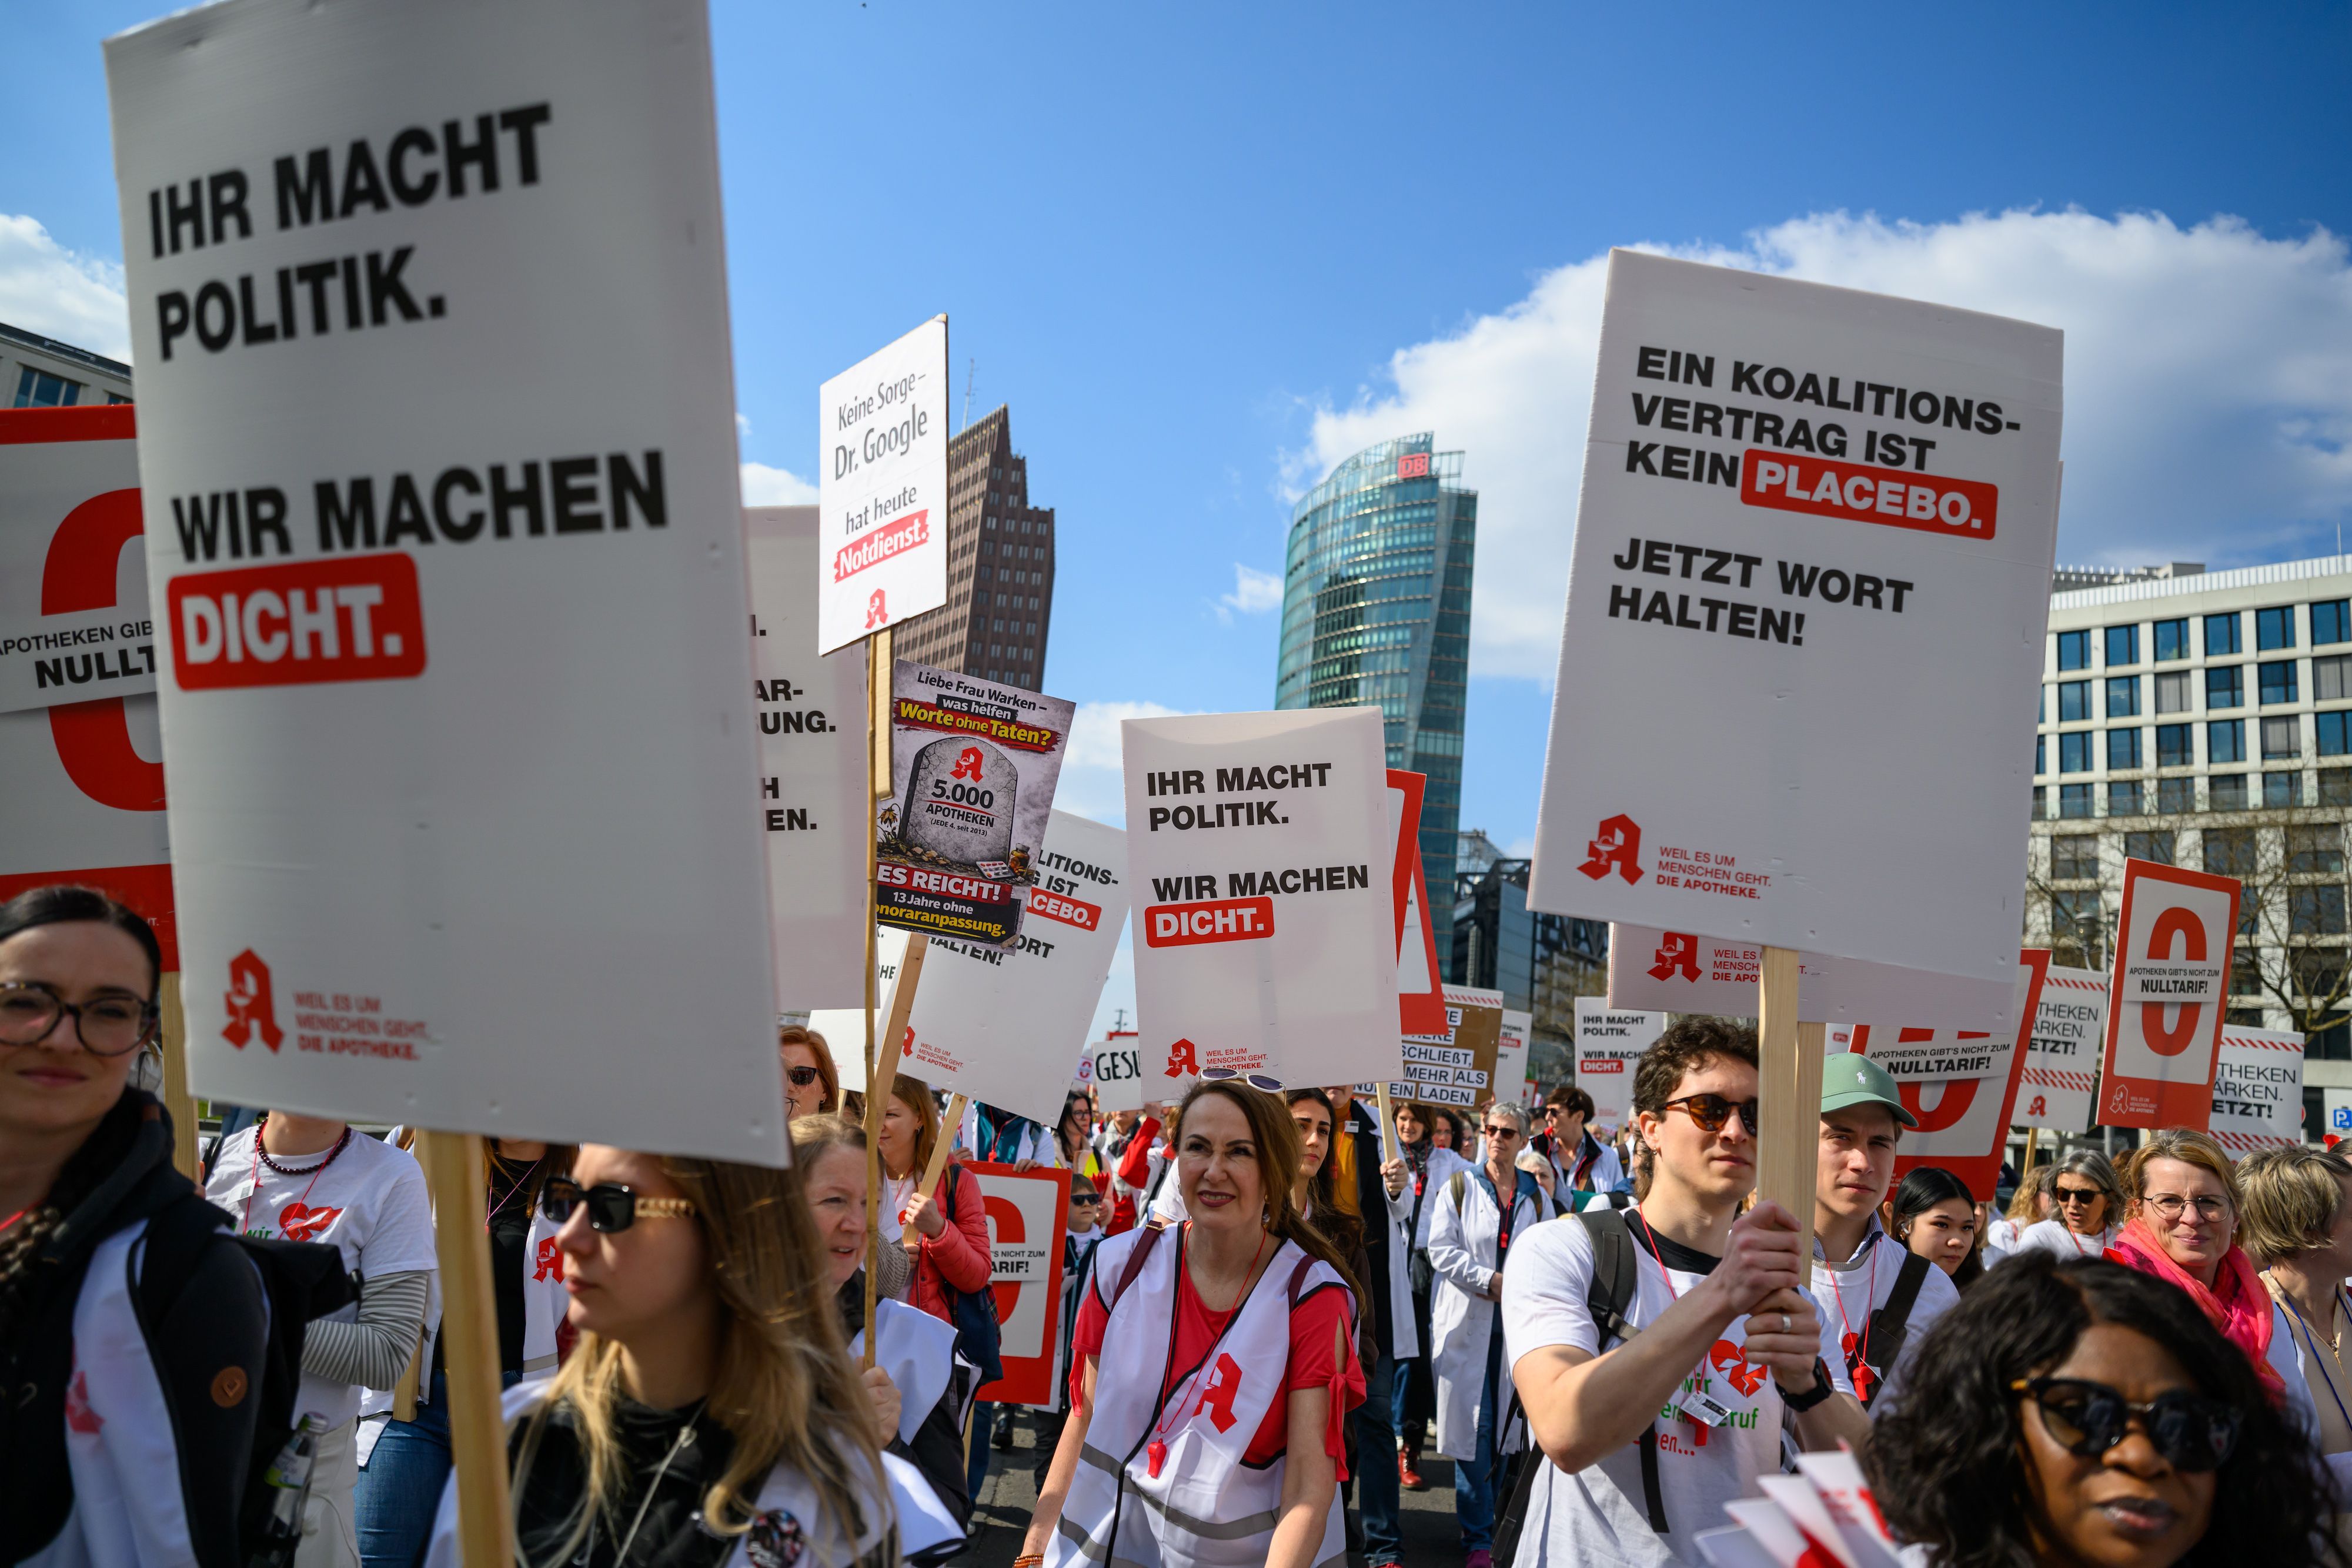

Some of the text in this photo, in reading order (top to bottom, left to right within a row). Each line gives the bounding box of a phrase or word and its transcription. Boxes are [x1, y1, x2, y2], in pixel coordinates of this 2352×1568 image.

[148, 101, 553, 260] IHR MACHT
[155, 244, 447, 363] POLITIK.
[838, 396, 874, 431] Keine
[877, 373, 916, 410] Sorge
[1636, 346, 2022, 436] EIN KOALITIONS-
[835, 403, 928, 481] Dr. Google
[1631, 392, 1936, 472] VERTRAG IST
[1401, 458, 1424, 474] DB
[1626, 440, 1983, 529] KEIN PLACEBO.
[171, 447, 669, 563] WIR MACHEN
[846, 486, 917, 536] hat heute
[839, 517, 927, 577] Notdienst.
[1613, 538, 1914, 614] JETZT WORT
[179, 583, 405, 665] DICHT.
[1608, 584, 1806, 647] HALTEN!
[119, 620, 154, 639] GIB
[35, 646, 156, 689] NULLT
[917, 671, 953, 690] Liebe
[956, 680, 985, 698] Frau
[988, 688, 1037, 711] Warken
[943, 698, 1011, 720] was helfen
[760, 710, 837, 734] UNG.
[900, 701, 1051, 746] Worte ohne Taten?
[1147, 763, 1332, 797] IHR MACHT
[931, 778, 994, 810] 5.000
[766, 808, 817, 831] EN.
[925, 803, 995, 828] APOTHEKEN
[930, 817, 948, 828] (JEDE
[957, 824, 969, 833] seit
[970, 826, 988, 837] 2013)
[1149, 800, 1289, 832] POLITIK.
[1037, 849, 1119, 885] LITIONS-
[1659, 846, 1736, 867] WEIL ES UM
[877, 864, 1001, 901] ES REICHT!
[1045, 874, 1080, 897] IST
[1151, 864, 1369, 902] WIR MACHEN
[1657, 860, 1772, 887] MENSCHEN GEHT.
[1656, 874, 1762, 900] DIE APOTHEKE.
[893, 891, 974, 915] 13 Jahre ohne
[1027, 891, 1092, 927] CEBO.
[876, 903, 1006, 937] noraranpassung.
[1155, 907, 1264, 938] DICHT.
[1017, 934, 1055, 959] ORT
[1713, 948, 1740, 959] WEIL
[1742, 950, 1756, 960] ES
[1712, 971, 1760, 983] DIE APO
[1713, 960, 1759, 972] MENSCH
[2129, 967, 2167, 976] APOTHEKEN
[2141, 979, 2209, 994] NULLTARIF!
[295, 1013, 380, 1035] MENSCHEN
[1583, 1015, 1646, 1025] IHR MACHT
[2039, 1002, 2099, 1022] THEKEN
[298, 1034, 324, 1052] DIE
[1583, 1028, 1631, 1037] POLITIK.
[918, 1048, 964, 1068] MENSCHEN GEHT.
[920, 1042, 933, 1051] WEIL
[1583, 1051, 1646, 1059] WIR MACH
[1870, 1043, 2011, 1059] APOTHEKEN GIBT'S NICHT ZUM
[2029, 1038, 2077, 1056] ETZT!
[927, 1058, 958, 1073] APOTHEKE.
[1095, 1050, 1141, 1082] GESU
[1207, 1056, 1247, 1065] MENSCHEN
[1582, 1062, 1622, 1072] DICHT.
[1887, 1057, 1992, 1075] NULLTARIF!
[1405, 1066, 1485, 1085] MEHR ALS
[2217, 1062, 2296, 1084] THEKEN
[1389, 1083, 1414, 1098] EIN
[1419, 1086, 1474, 1105] LADEN.
[2211, 1099, 2273, 1119] ETZT!
[991, 1261, 1030, 1273] ARIF!
